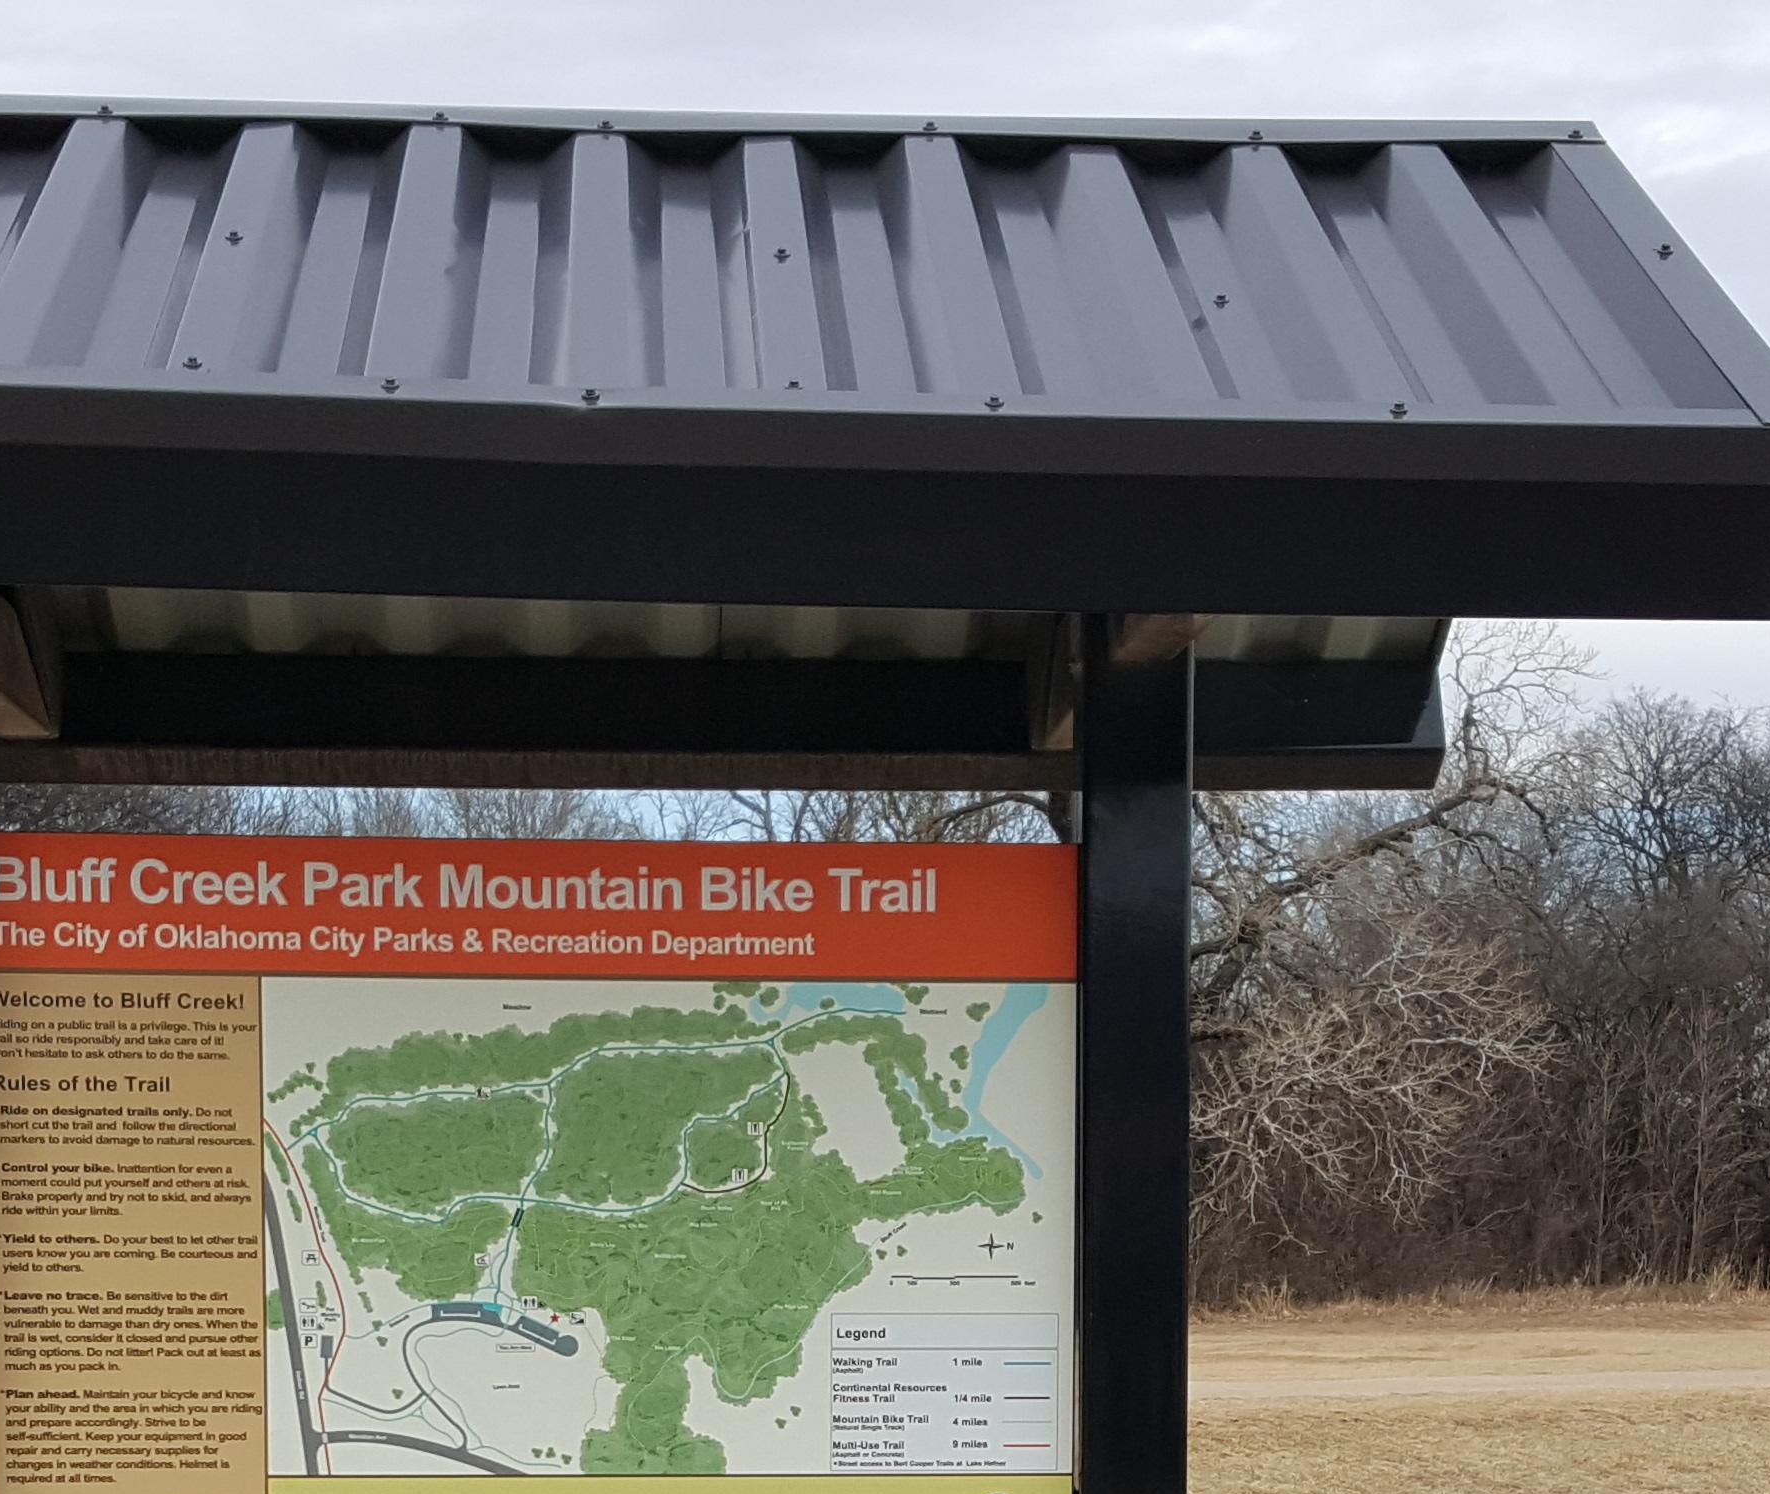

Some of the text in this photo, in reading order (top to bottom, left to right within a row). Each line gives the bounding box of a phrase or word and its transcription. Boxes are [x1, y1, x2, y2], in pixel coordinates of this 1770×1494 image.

[130, 858, 287, 905] Creek
[303, 861, 424, 907] Park
[439, 864, 682, 911] Mountain
[701, 867, 814, 912] Bike
[828, 868, 936, 912] Trail
[54, 921, 110, 953] City
[118, 923, 148, 949] of
[154, 923, 301, 950] Oklahoma
[309, 925, 365, 957] City
[374, 927, 453, 952] Parks
[462, 928, 482, 952] &
[492, 929, 642, 954] Recreation
[651, 929, 815, 960] Department
[93, 992, 113, 1009] to
[120, 992, 170, 1009] Bluff
[176, 992, 244, 1010] Creek!
[30, 1022, 45, 1030] on
[47, 1022, 55, 1030] a
[56, 1020, 91, 1032] public
[93, 1020, 115, 1030] trail
[117, 1020, 127, 1030] is
[139, 1020, 189, 1032] privilege.
[193, 1021, 216, 1031] This
[218, 1021, 229, 1031] is
[231, 1024, 256, 1033] your
[31, 1033, 53, 1044] ride
[55, 1034, 121, 1046] responsibly
[123, 1034, 145, 1044] and
[147, 1034, 171, 1045] take
[173, 1037, 198, 1045] care
[200, 1035, 212, 1045] of
[213, 1035, 224, 1045] it!
[24, 1048, 68, 1058] hesitate
[70, 1048, 82, 1058] to
[84, 1048, 104, 1058] ask
[107, 1048, 143, 1059] others
[145, 1049, 157, 1059] to
[159, 1049, 174, 1059] do
[176, 1049, 194, 1059] the
[57, 1076, 78, 1093] of
[84, 1076, 117, 1093] the
[127, 1076, 170, 1094] Trail
[0, 1134, 255, 1147] markers to avoid damage to natural resources.
[0, 1177, 249, 1189] moment could put yourself and others at risk.
[2, 1205, 121, 1217] ride within your limits.
[1006, 1242, 1014, 1250] N
[4, 1304, 48, 1314] beneath
[50, 1307, 75, 1316] you.
[77, 1305, 99, 1315] Wet
[101, 1305, 123, 1315] and
[125, 1305, 164, 1317] muddy
[166, 1305, 194, 1315] trails
[4, 1318, 62, 1328] vulnerable
[63, 1319, 75, 1329] to
[77, 1319, 122, 1330] damage
[124, 1319, 150, 1329] than
[152, 1319, 170, 1331] dry
[205, 1319, 238, 1329] When
[240, 1319, 258, 1329] the
[836, 1328, 886, 1341] Legend
[304, 1335, 313, 1346] P
[832, 1358, 898, 1367] Walking Trail
[952, 1358, 983, 1366] 1 mile
[832, 1384, 947, 1392] Continental Resources
[833, 1394, 895, 1402] Fitness Trail
[954, 1394, 992, 1403] 1/4 mile
[832, 1415, 929, 1424] Mountain Bike Trail
[952, 1418, 988, 1426] 4 miles
[832, 1441, 904, 1450] Multi-Use Trail
[952, 1440, 988, 1448] 9 miles
